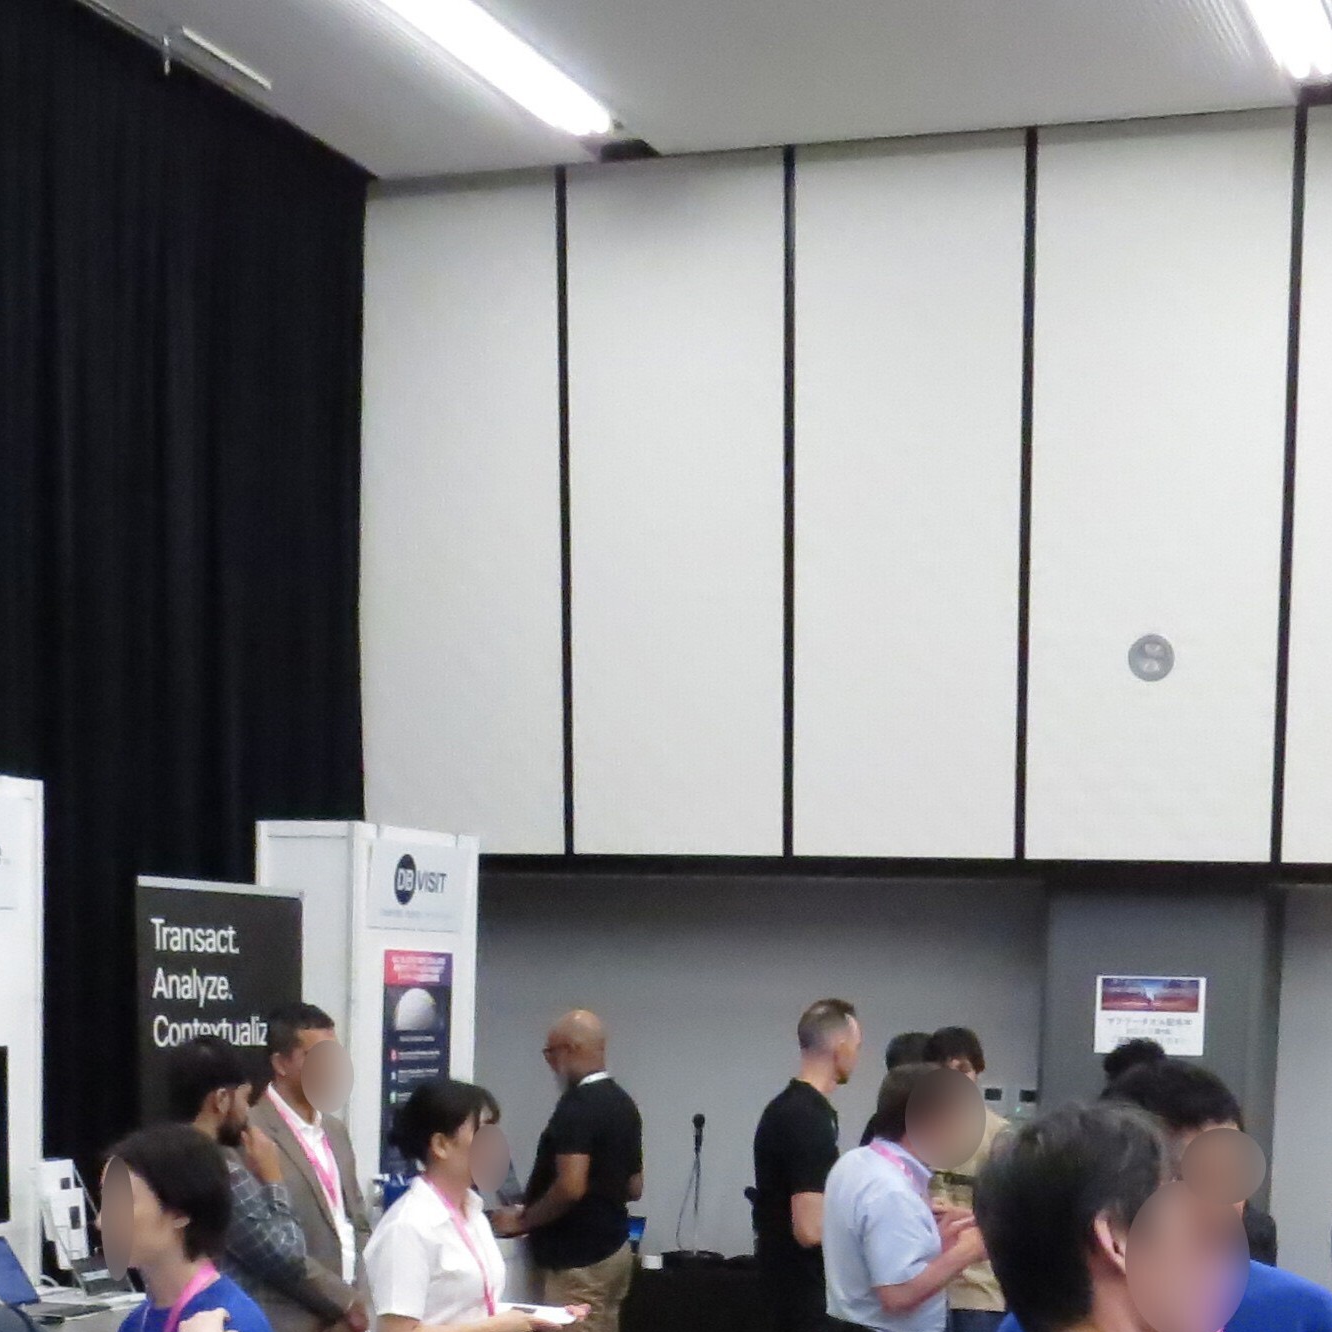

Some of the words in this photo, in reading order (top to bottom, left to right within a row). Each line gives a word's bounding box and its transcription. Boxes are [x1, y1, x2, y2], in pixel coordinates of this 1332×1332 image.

[150, 917, 240, 954] Transact.
[152, 966, 233, 1008] Analyze.
[153, 1014, 268, 1048] Contextualiz
